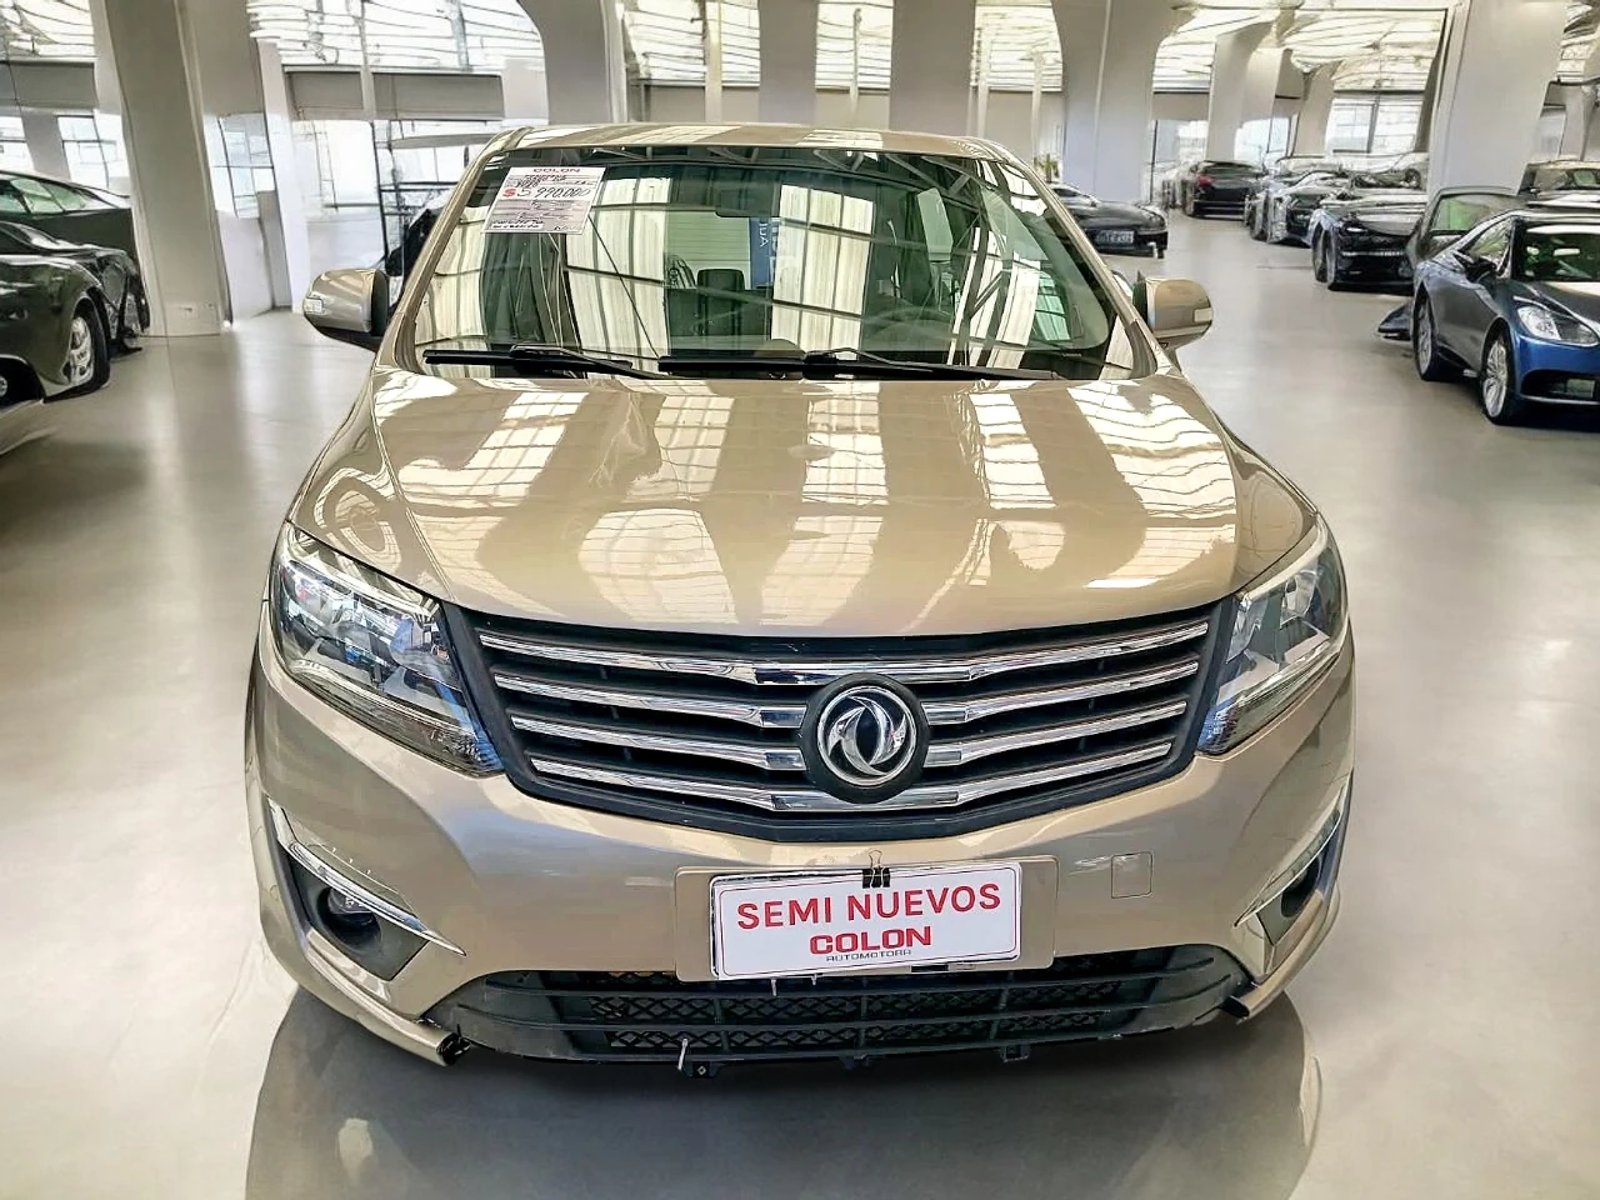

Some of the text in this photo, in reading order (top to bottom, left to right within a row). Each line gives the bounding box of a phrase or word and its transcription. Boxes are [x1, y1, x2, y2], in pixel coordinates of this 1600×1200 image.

[737, 883, 1001, 930] SEMI NUEVOS
[809, 926, 932, 955] COLON
[825, 950, 912, 962] AUTOMOTORA
